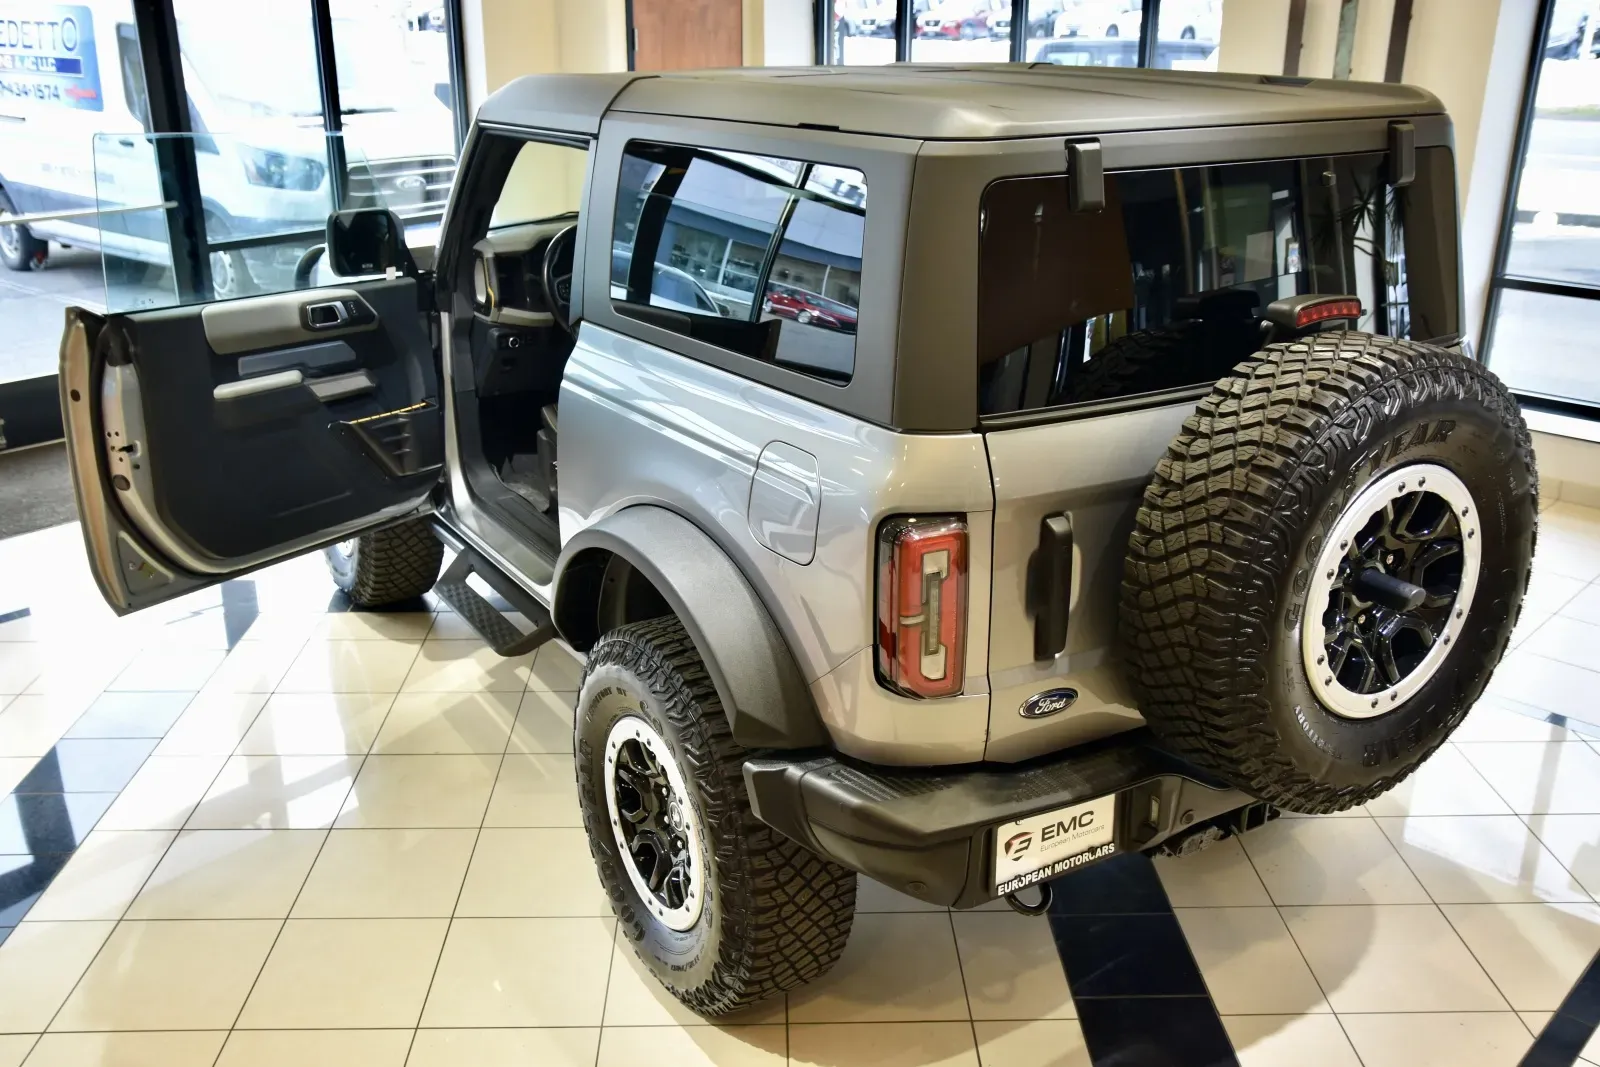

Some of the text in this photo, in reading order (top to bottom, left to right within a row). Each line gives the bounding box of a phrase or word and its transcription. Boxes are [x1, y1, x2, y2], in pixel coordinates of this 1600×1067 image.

[38, 57, 57, 72] LLC
[1034, 695, 1066, 714] Ford
[1040, 824, 1105, 853] European Motorcars
[1041, 810, 1095, 842] EMC
[997, 843, 1115, 896] EUROPEAN MOTORCARS
